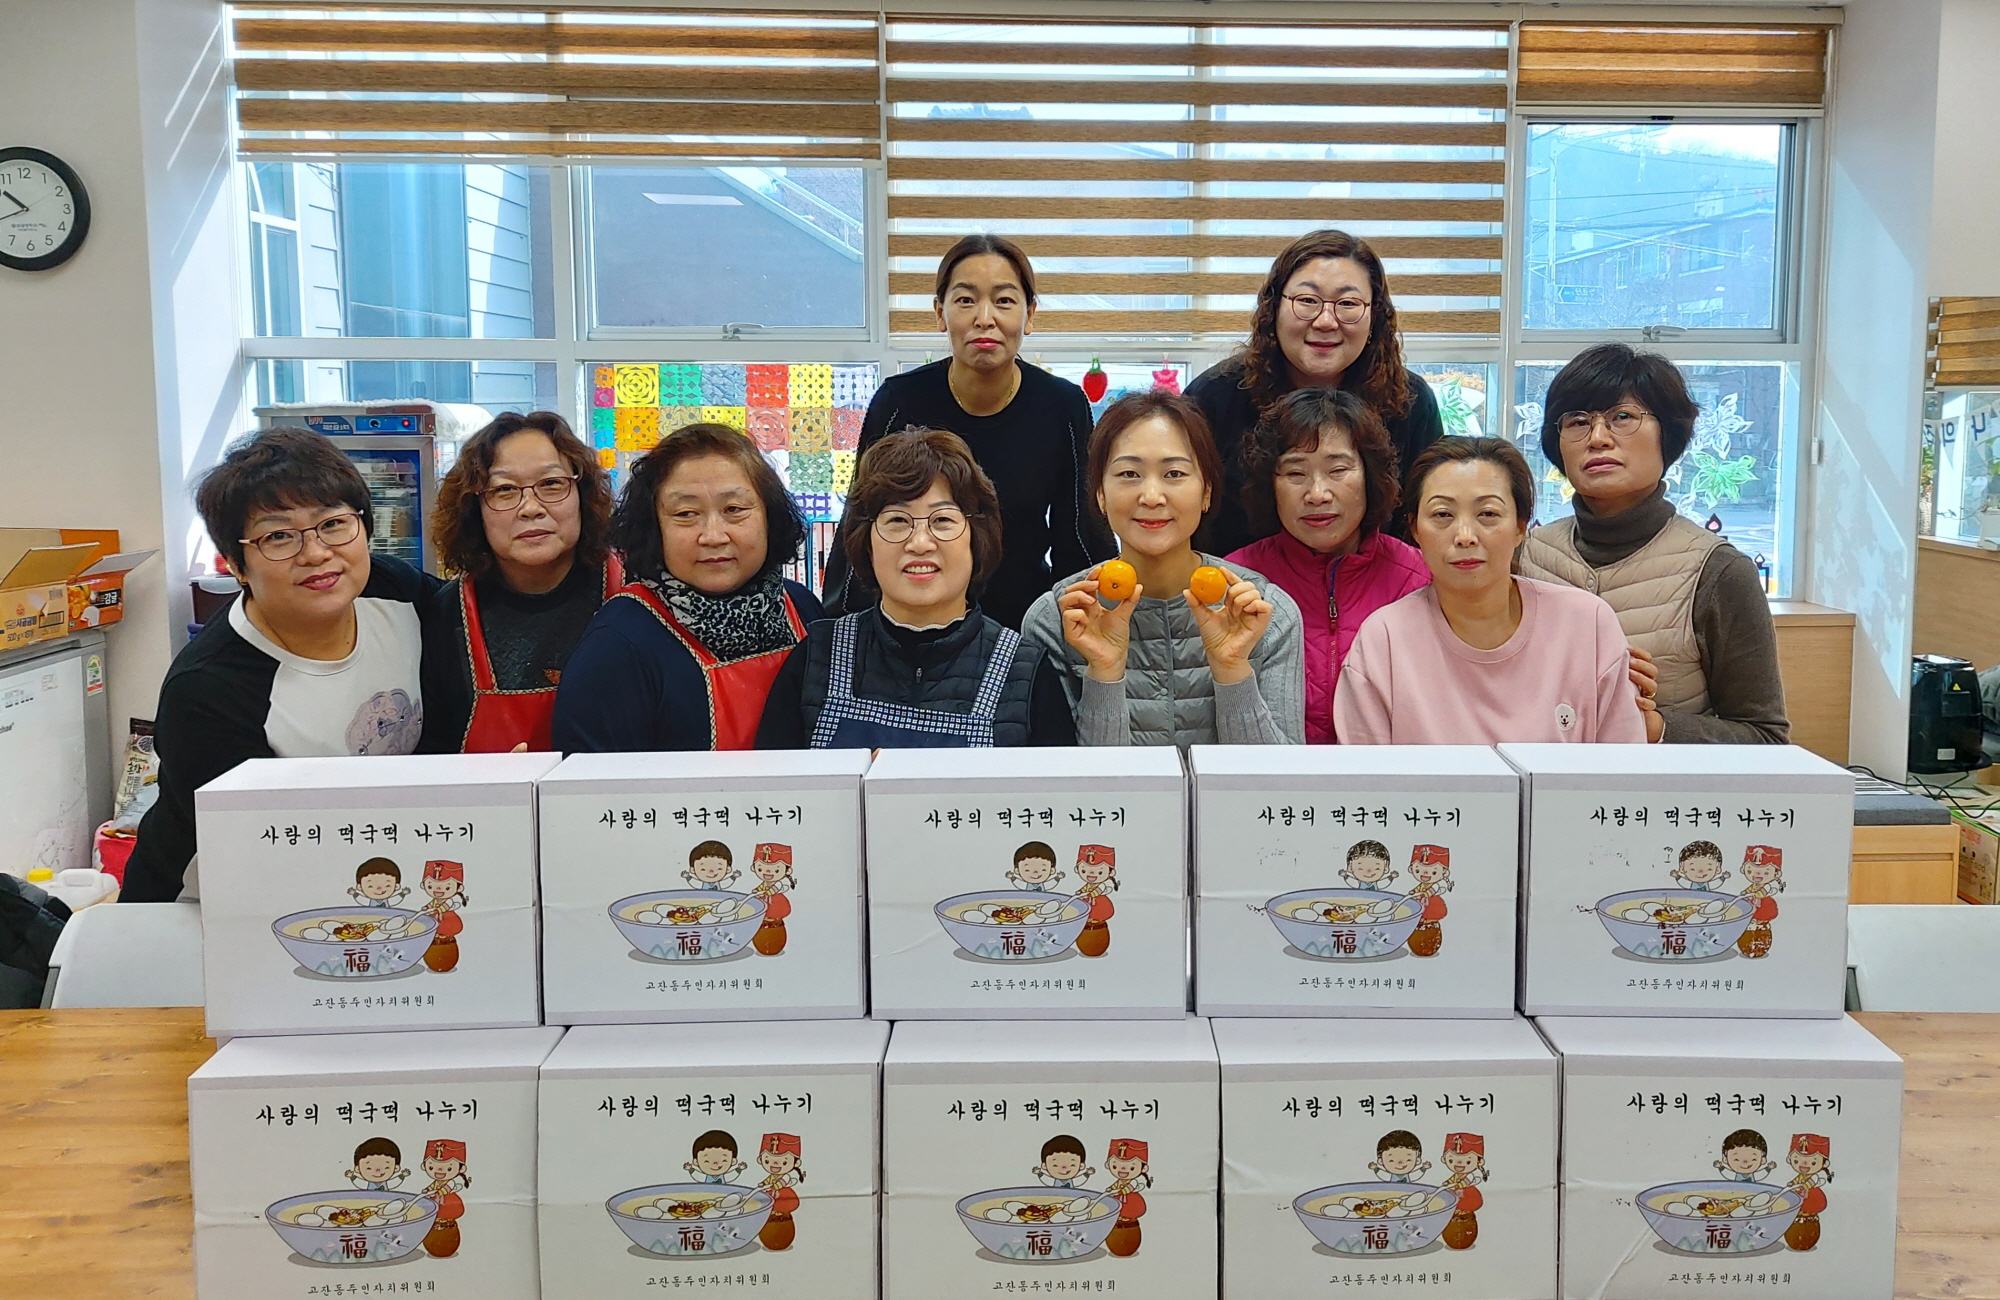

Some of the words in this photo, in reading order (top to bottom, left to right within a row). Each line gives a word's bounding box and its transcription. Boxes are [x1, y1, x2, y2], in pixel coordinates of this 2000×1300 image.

[0, 173, 12, 184] 11
[17, 167, 31, 179] 12
[42, 173, 47, 184] 1
[55, 186, 63, 197] 2
[63, 204, 71, 214] 3
[58, 221, 66, 232] 4
[8, 235, 16, 246] 7
[27, 240, 35, 251] 6
[45, 235, 54, 246] 5
[104, 591, 117, 605] 감귤
[598, 807, 657, 830] 사랑의
[671, 806, 730, 829] 떡국떡
[744, 805, 802, 827] 나누기
[924, 808, 981, 830] 사랑의
[996, 806, 1053, 829] 떡국떡
[1068, 806, 1125, 828] 나누기
[1257, 805, 1315, 827] 사랑의
[1330, 805, 1388, 828] 떡국떡
[1403, 806, 1461, 828] 나누기
[1589, 805, 1648, 827] 사랑의
[1663, 806, 1722, 829] 떡국떡
[1736, 807, 1795, 829] 나누기
[260, 824, 321, 846] 사랑의
[337, 822, 398, 845] 떡국떡
[413, 822, 474, 844] 나누기
[675, 930, 703, 956] 福
[999, 930, 1027, 956] 福
[1330, 929, 1358, 955] 福
[1662, 928, 1687, 957] 福
[344, 947, 371, 973] 福
[255, 1103, 319, 1127] 사랑의
[335, 1100, 399, 1125] 떡국떡
[415, 1098, 478, 1122] 나누기
[597, 1094, 659, 1118] 사랑의
[674, 1093, 735, 1117] 떡국떡
[751, 1092, 812, 1115] 나누기
[946, 1099, 1007, 1122] 사랑의
[1023, 1098, 1083, 1122] 떡국떡
[1099, 1098, 1159, 1121] 나누기
[1281, 1095, 1342, 1119] 사랑의
[1358, 1093, 1418, 1118] 떡국떡
[1434, 1092, 1494, 1116] 나누기
[1626, 1092, 1688, 1115] 사랑의
[1704, 1092, 1765, 1116] 떡국떡
[1781, 1094, 1842, 1116] 나누기
[338, 1233, 369, 1260] 福
[677, 1225, 706, 1252] 福
[1025, 1229, 1054, 1256] 福
[1362, 1224, 1390, 1250] 福
[1704, 1220, 1733, 1250] 福
